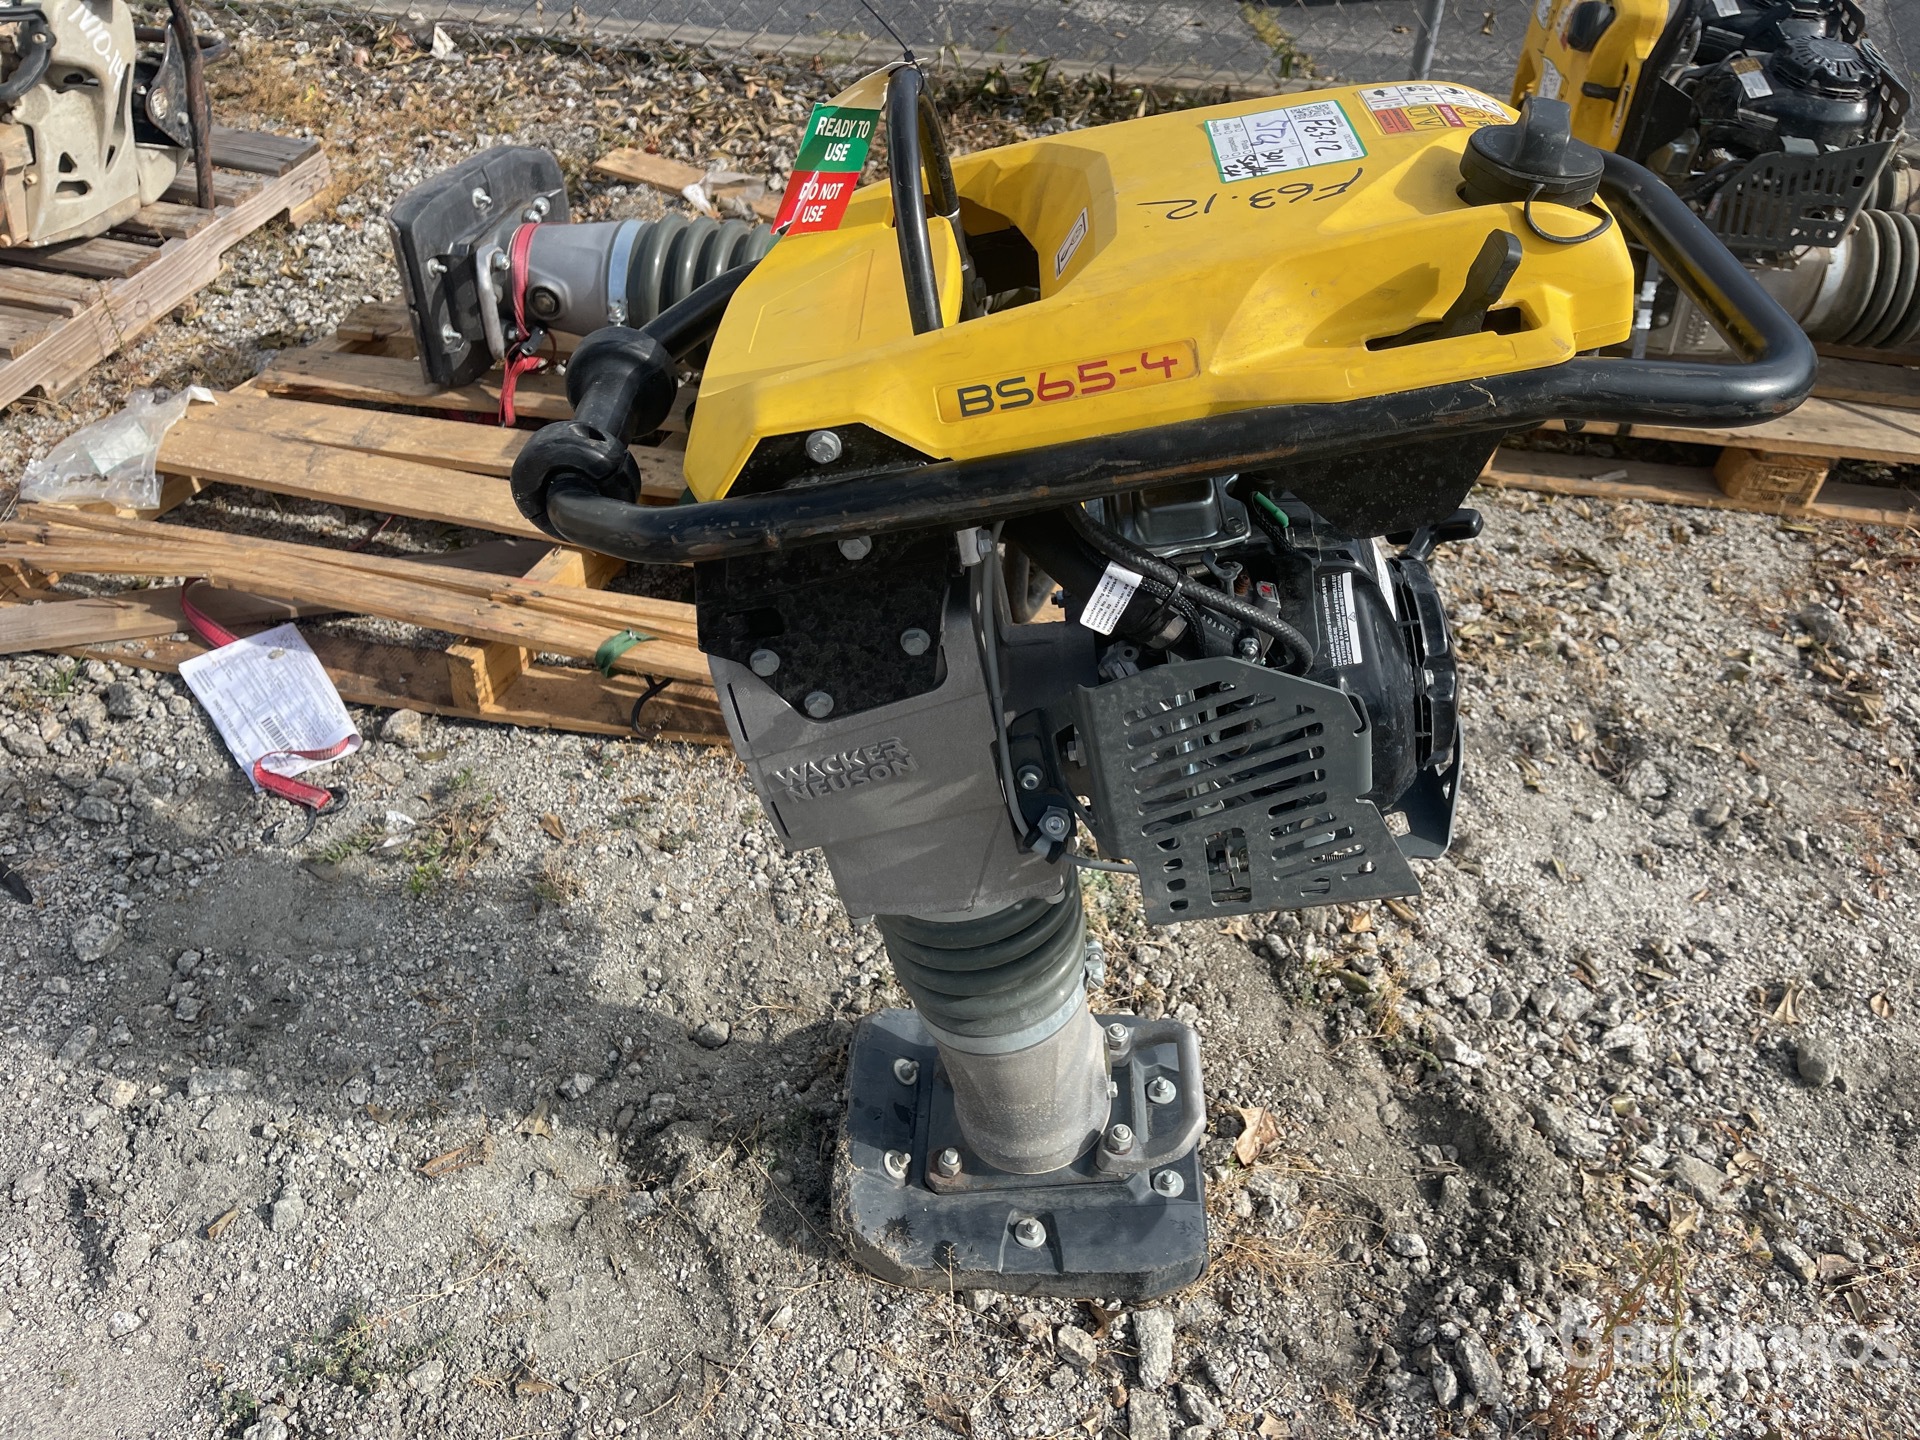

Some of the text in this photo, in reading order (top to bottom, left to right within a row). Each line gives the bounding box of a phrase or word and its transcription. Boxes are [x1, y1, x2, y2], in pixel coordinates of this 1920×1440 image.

[814, 116, 871, 139] READY TO
[824, 142, 851, 162] USE
[798, 182, 844, 200] DO NOT
[1137, 168, 1363, 220] F63.12
[801, 205, 826, 223] USE
[957, 351, 1178, 418] BS65-4
[1321, 587, 1329, 607] COMPLIES
[773, 736, 908, 787] WACKER
[785, 752, 919, 803] NEUSON
